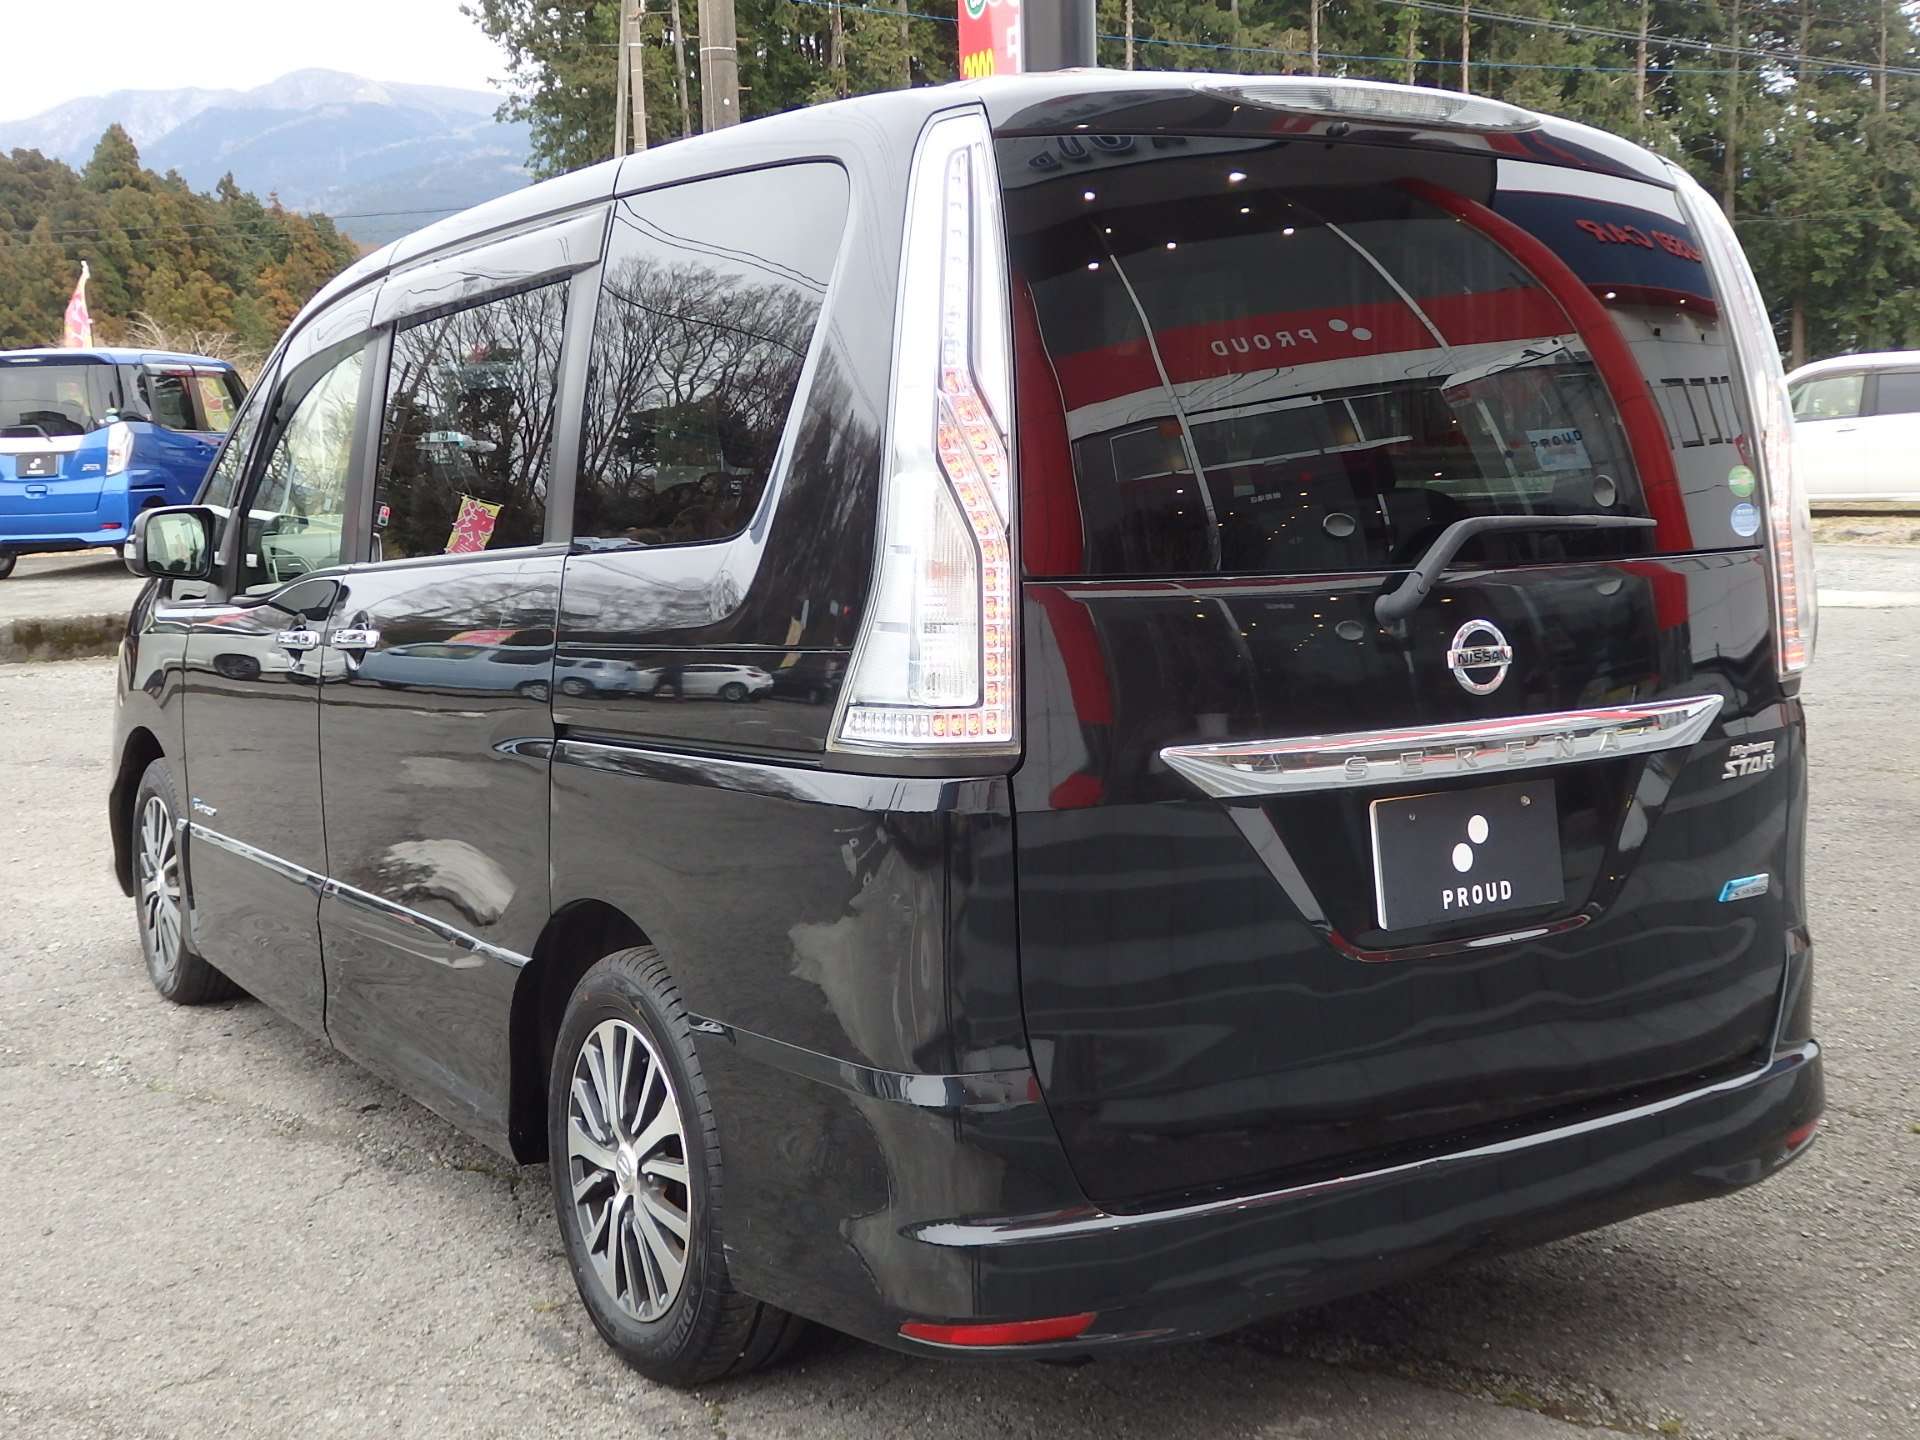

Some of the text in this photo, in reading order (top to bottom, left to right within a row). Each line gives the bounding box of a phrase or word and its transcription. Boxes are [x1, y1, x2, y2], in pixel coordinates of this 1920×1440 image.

[1530, 430, 1582, 451] PROUD
[1458, 649, 1509, 664] NISSAN
[1344, 730, 1621, 780] SERENA
[1721, 753, 1776, 780] STAR
[1442, 880, 1512, 910] PROUD
